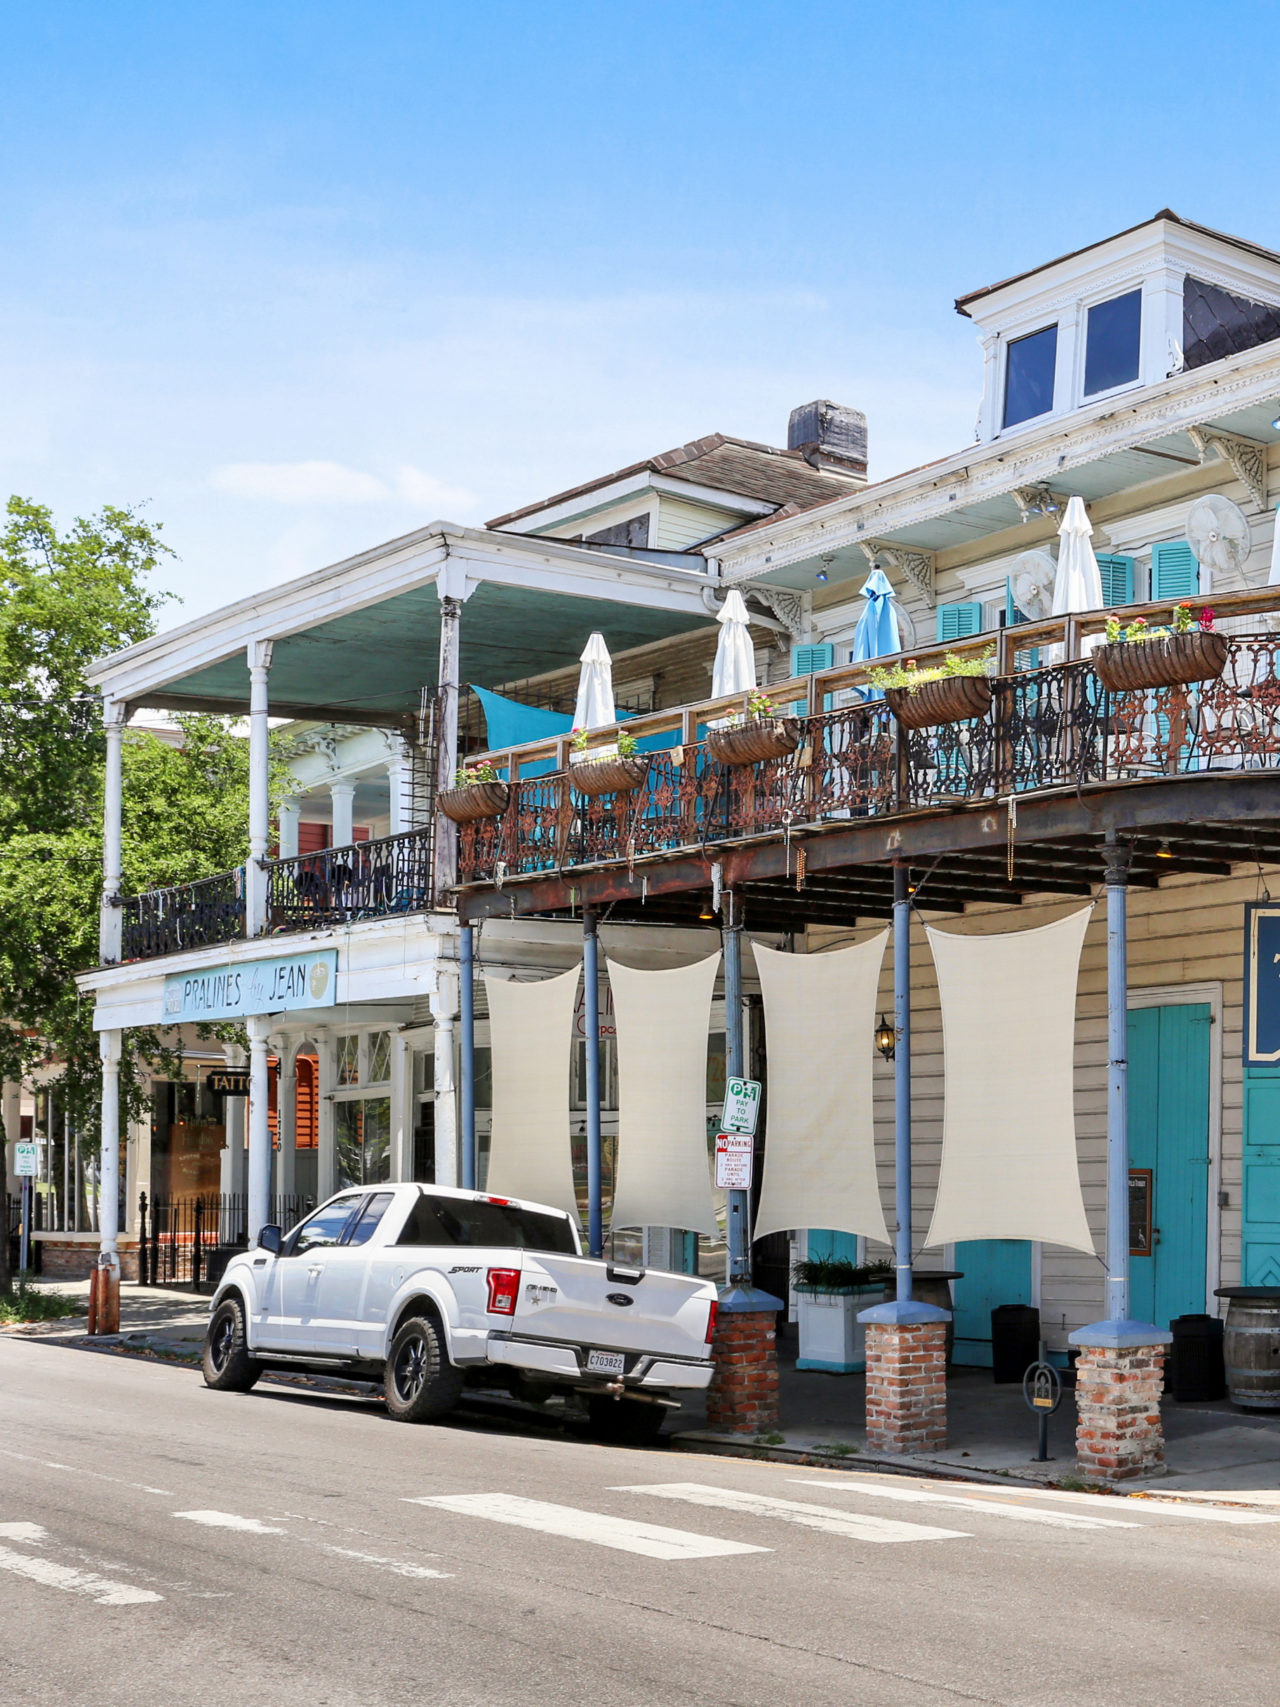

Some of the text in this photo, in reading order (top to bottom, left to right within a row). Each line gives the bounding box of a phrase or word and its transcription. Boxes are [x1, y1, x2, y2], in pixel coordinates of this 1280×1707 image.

[183, 973, 241, 1012] PRALINES
[269, 964, 306, 1000] JEAN
[735, 1098, 749, 1107] PAY
[736, 1107, 746, 1115] TO
[730, 1115, 749, 1124] PARK
[717, 1138, 751, 1149] NO PARKING
[590, 1355, 623, 1369] C703822
